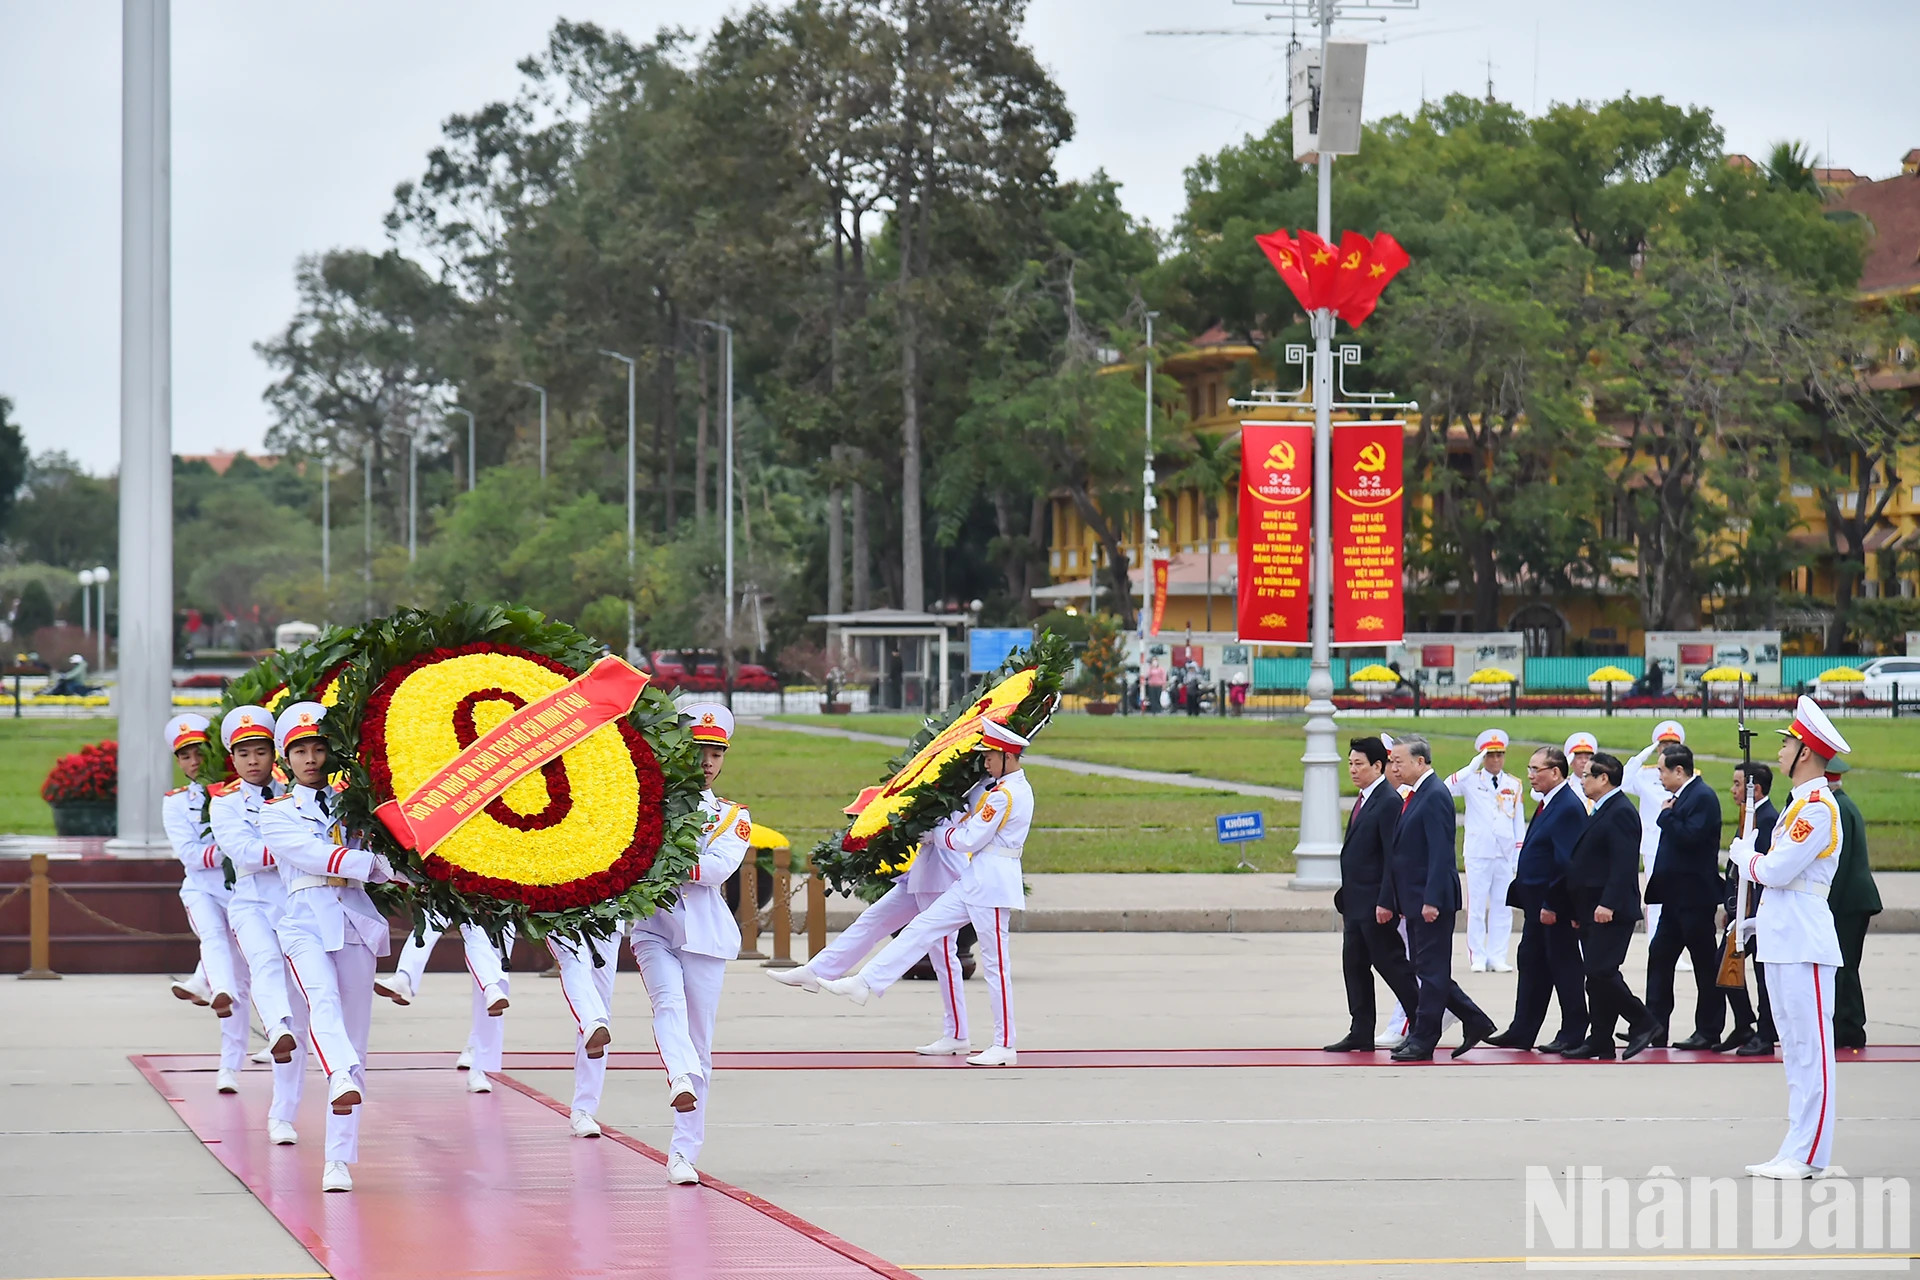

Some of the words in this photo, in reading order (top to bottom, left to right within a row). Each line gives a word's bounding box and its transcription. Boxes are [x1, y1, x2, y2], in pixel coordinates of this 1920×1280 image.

[1269, 473, 1291, 486] 3-2
[1359, 475, 1381, 488] 3-2
[1259, 486, 1302, 495] 1930-2025
[554, 698, 576, 715] VĨ
[564, 692, 591, 708] ĐẠI
[520, 716, 546, 738] CHÍ
[534, 706, 568, 730] MINH
[507, 723, 532, 744] HỒ
[488, 735, 520, 757] TỊCH
[471, 746, 500, 771] CHỦ
[457, 764, 483, 781] ƠN
[437, 772, 468, 796] NHỚ
[422, 789, 450, 808] ĐỜI
[451, 800, 470, 815] BAN
[463, 789, 482, 806] CHẤP
[407, 802, 434, 821] ĐỜI
[1225, 816, 1255, 829] KHÔNG
